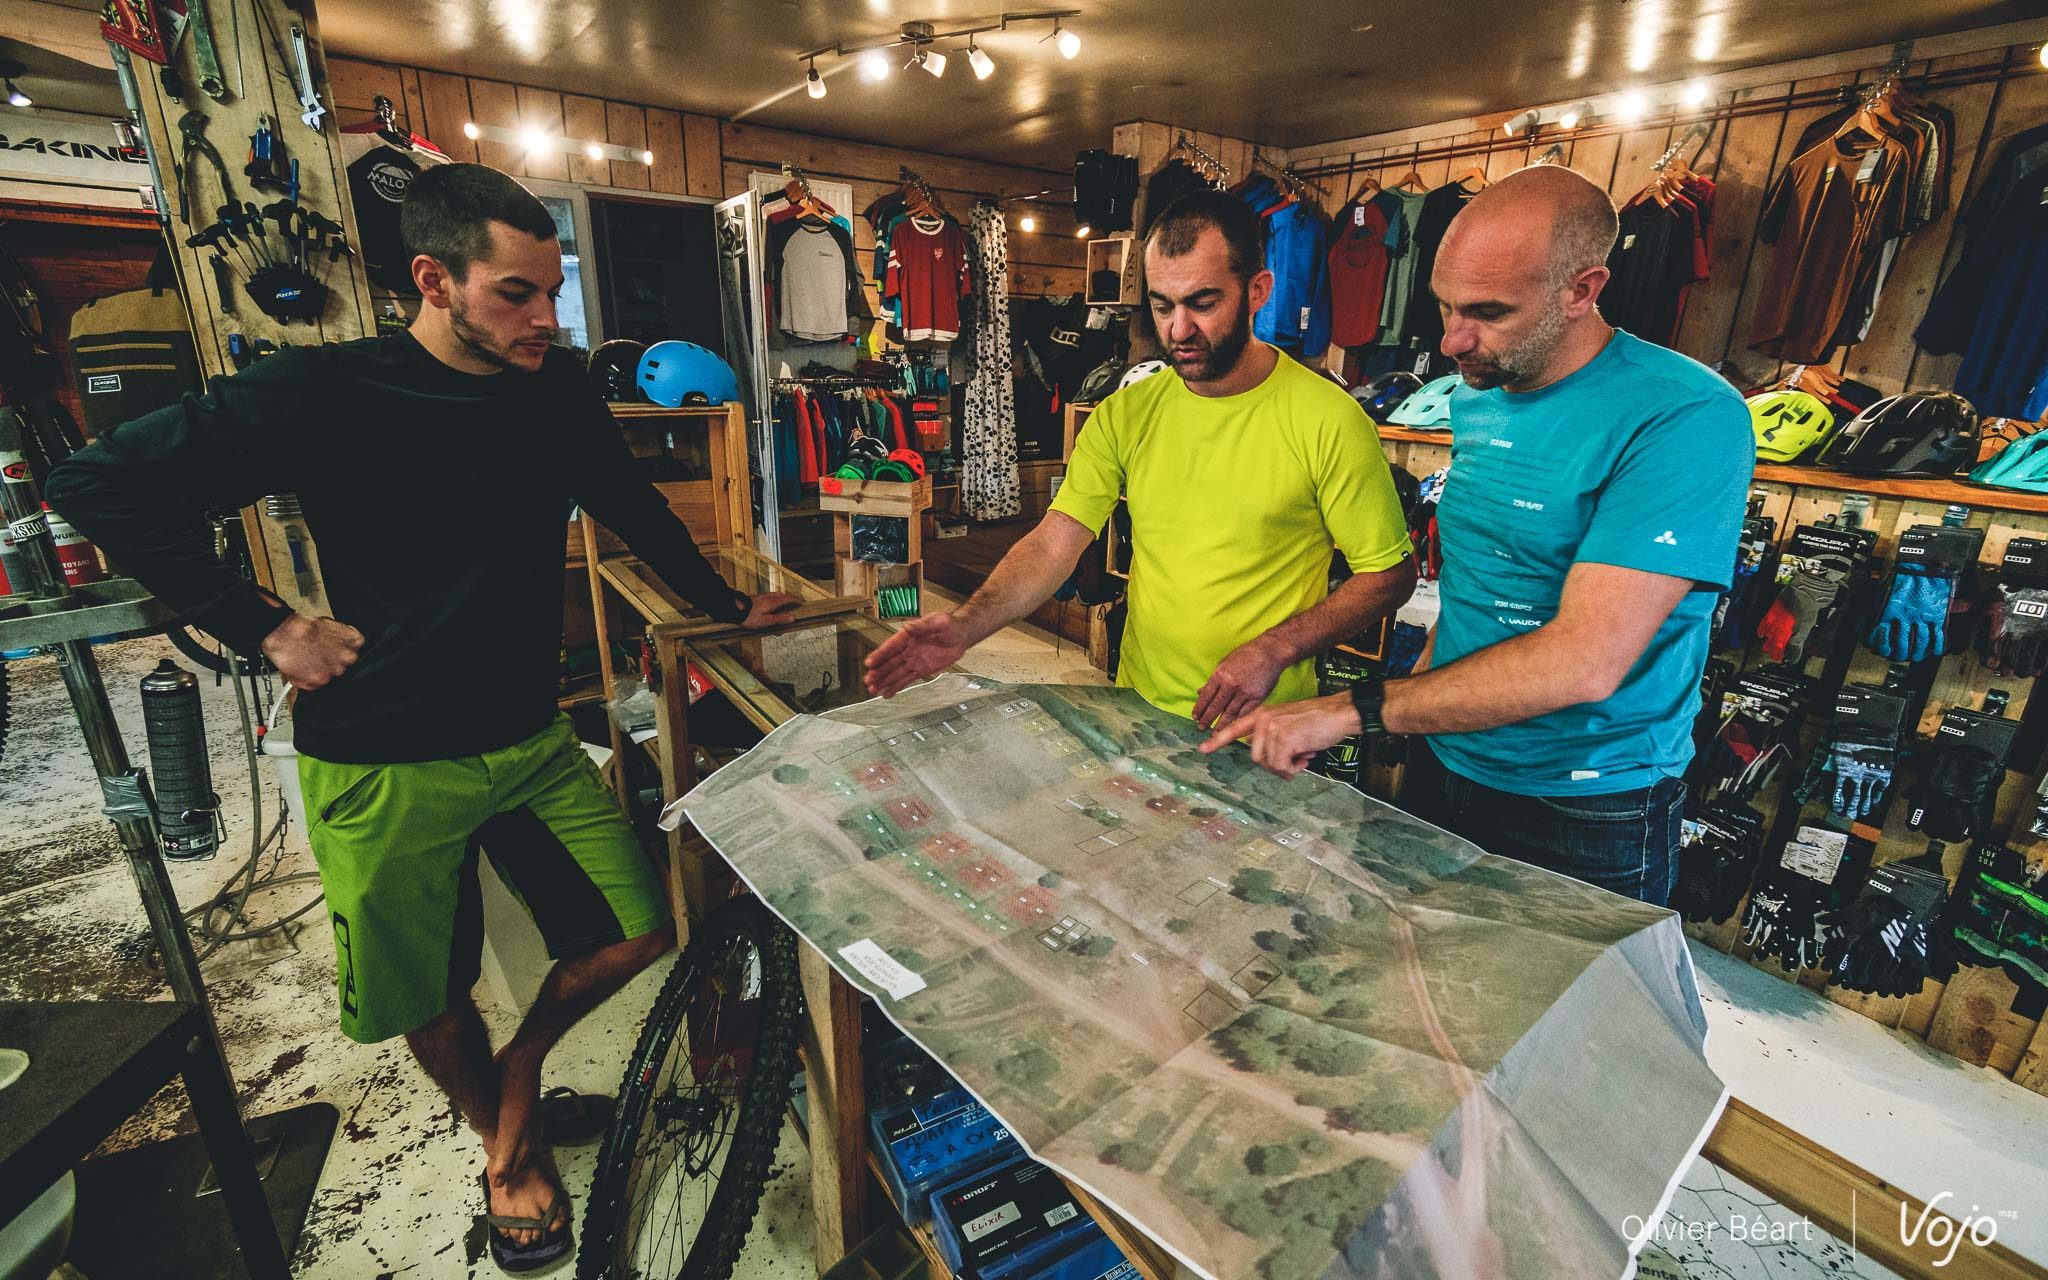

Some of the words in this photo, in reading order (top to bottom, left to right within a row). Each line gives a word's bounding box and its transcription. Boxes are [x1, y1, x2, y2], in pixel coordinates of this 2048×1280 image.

[367, 171, 406, 190] MALO
[1797, 533, 1851, 548] ENDURA
[1508, 618, 1542, 627] VAUDE
[1739, 680, 1789, 698] ENDURA
[993, 1127, 1010, 1141] 25
[1105, 1265, 1123, 1280] Brake
[1636, 1264, 1679, 1280] ents
